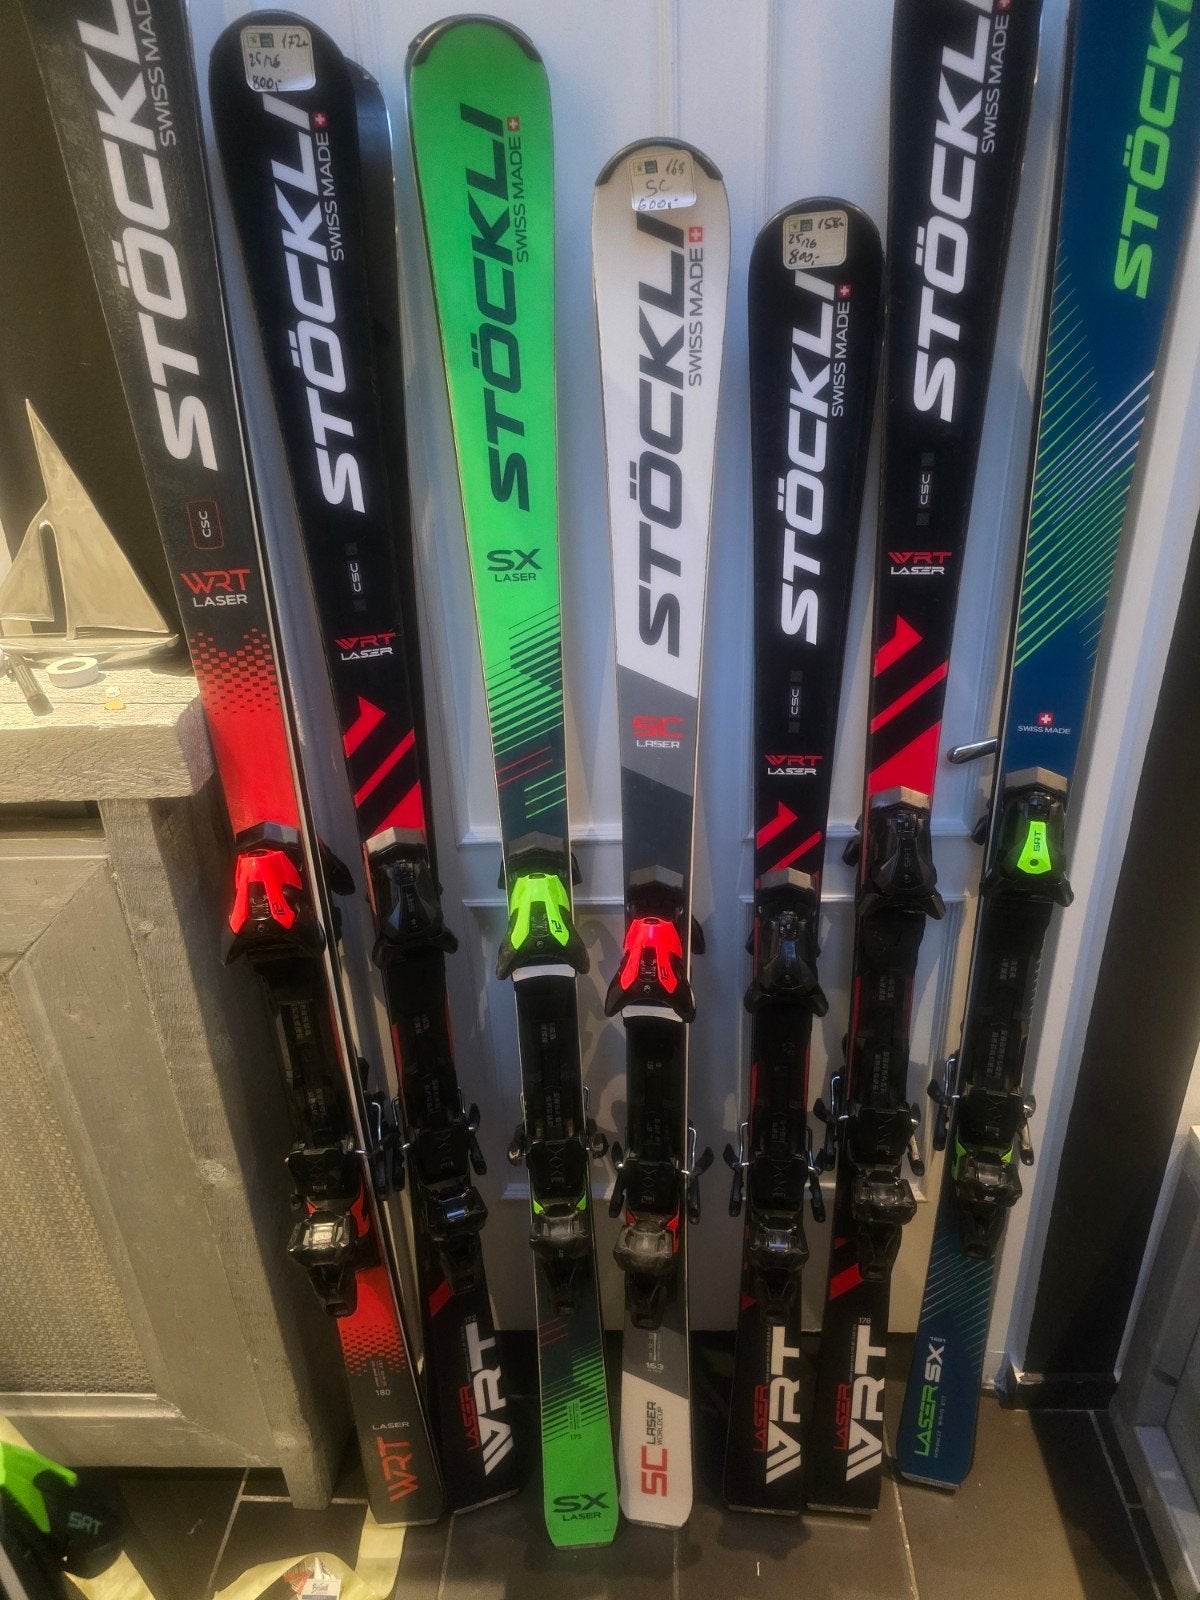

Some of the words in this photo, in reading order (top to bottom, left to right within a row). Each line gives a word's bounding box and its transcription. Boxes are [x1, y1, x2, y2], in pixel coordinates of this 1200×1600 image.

[988, 14, 1010, 84] MADE
[148, 67, 176, 147] SWISS
[981, 88, 1000, 154] SWISS
[317, 132, 336, 198] MADE
[508, 137, 525, 199] MADE
[1114, 0, 1193, 299] STÖCK
[645, 179, 673, 198] SC
[913, 0, 993, 423] STÖCKL
[321, 201, 345, 262] SWISS
[516, 202, 528, 263] SWISS
[262, 93, 366, 513] STÖCKLI
[689, 247, 704, 316] MADE
[460, 102, 530, 513] STÖCKLI
[835, 302, 850, 359] MADE
[688, 321, 703, 386] SWISS
[831, 362, 847, 417] SWISS
[630, 212, 685, 658] STÖCKLI
[777, 269, 836, 645] STÖCKLI
[920, 473, 930, 505] CSC
[198, 510, 212, 538] CSC
[180, 568, 251, 595] WRT
[350, 562, 362, 593] CSC
[487, 548, 543, 571] SX
[494, 572, 537, 583] LASER
[887, 551, 953, 564] WRT
[890, 565, 945, 575] LASER
[193, 594, 248, 608] LASER
[334, 632, 396, 650] WRT
[341, 647, 393, 661] LASER
[791, 688, 800, 715] CSC
[632, 715, 684, 738] SC
[636, 740, 680, 749] LASER
[1017, 725, 1044, 734] SWISS
[1044, 726, 1071, 735] MADE
[764, 754, 823, 767] WRT
[767, 767, 817, 776] LASER
[1034, 830, 1042, 852] SRT
[924, 1342, 945, 1383] SX
[375, 1388, 391, 1396] 180
[465, 1321, 514, 1477] WRT
[765, 1325, 801, 1484] WRT
[846, 1324, 887, 1482] WRT
[372, 1421, 410, 1431] LASER
[460, 1384, 480, 1451] LASER
[647, 1401, 657, 1445] LASER
[753, 1384, 769, 1453] LASER
[834, 1383, 852, 1450] LASER
[914, 1384, 938, 1457] LASER
[376, 1436, 419, 1501] WRT
[641, 1445, 668, 1497] SC
[68, 1511, 103, 1535] SRT
[553, 1492, 610, 1513] SX
[562, 1511, 601, 1522] LASER
